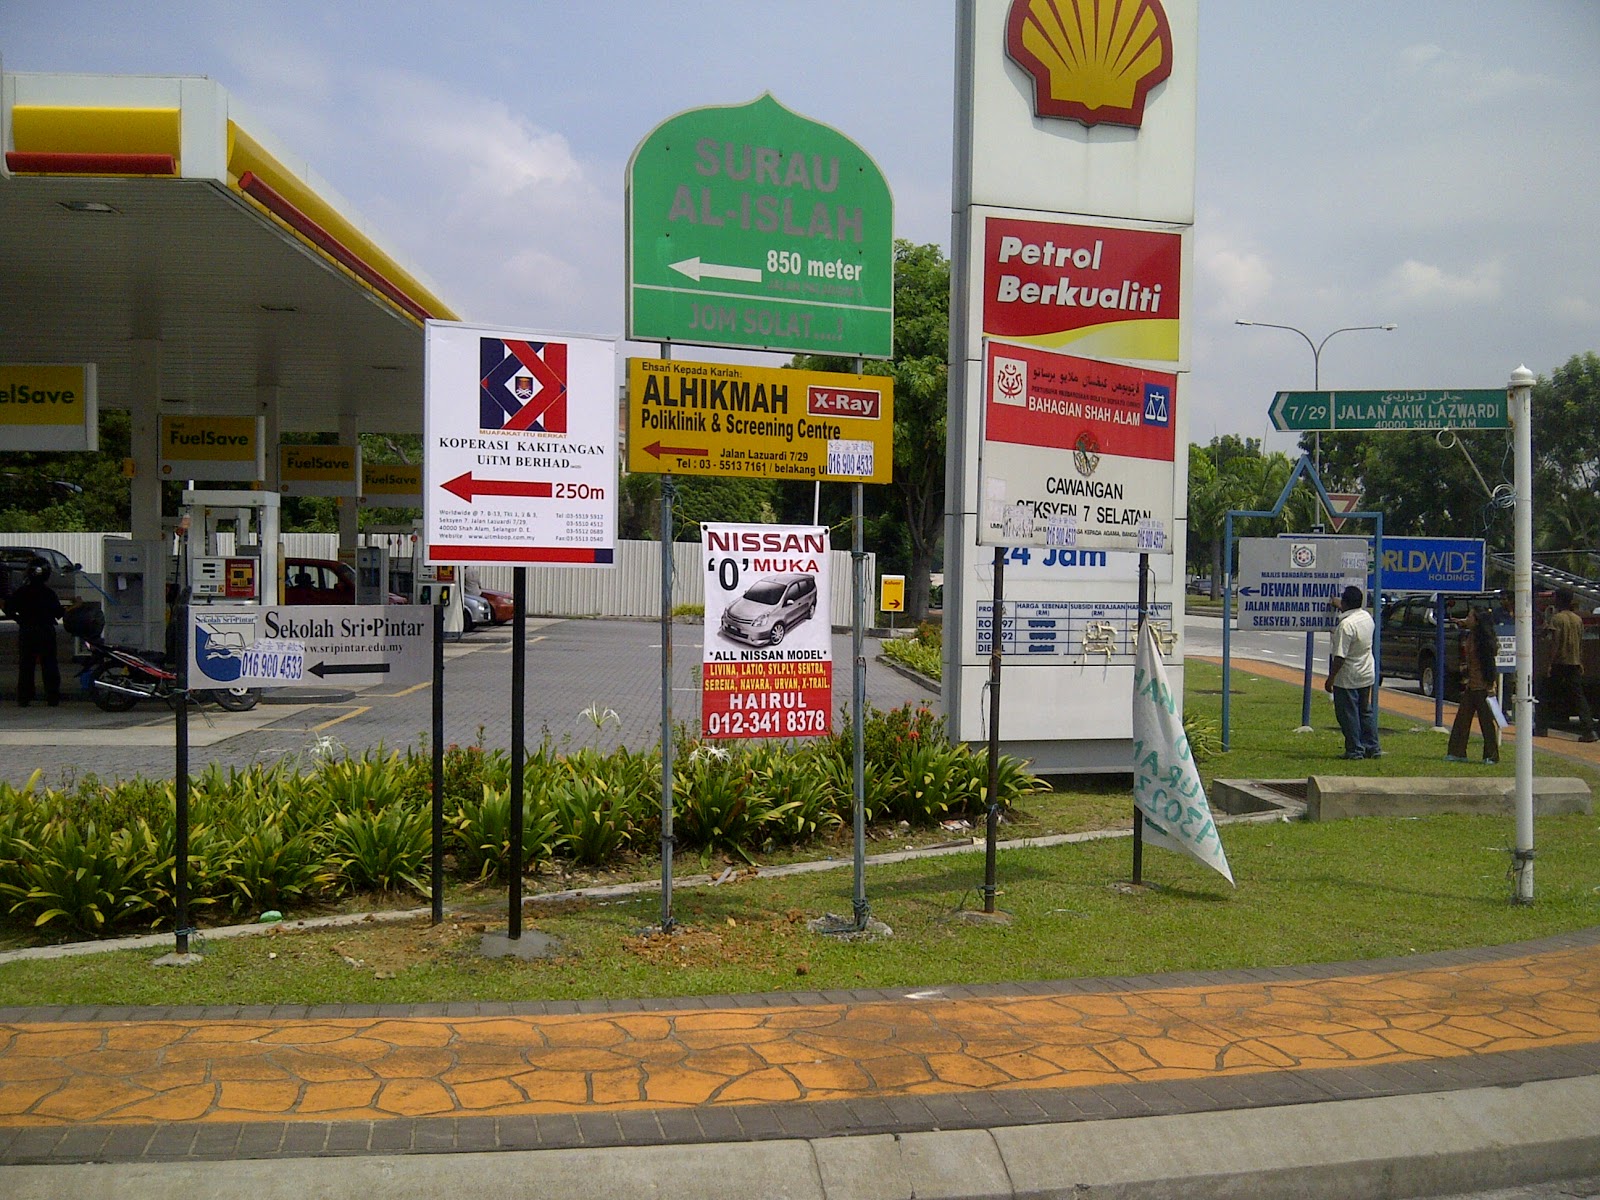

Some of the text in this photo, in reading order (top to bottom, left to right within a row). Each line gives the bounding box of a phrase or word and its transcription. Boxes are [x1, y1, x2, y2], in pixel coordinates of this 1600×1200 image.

[694, 137, 840, 193] SURAU
[668, 183, 864, 243] AL-ISLAH
[998, 236, 1103, 270] Petrol
[766, 250, 862, 281] 850 meter
[997, 275, 1162, 312] Berkualiti
[688, 303, 736, 333] JOM
[642, 361, 743, 378] Ehsan Kepada Kariah:
[642, 375, 788, 414] ALHIKMAH
[814, 392, 875, 415] X-Ray
[1028, 396, 1140, 426] BAHAGIAN SHAH ALAM
[1289, 403, 1499, 421] 7/29 JALAN AKIK LAZWARDI
[479, 429, 521, 437] MUAFAKAT
[641, 408, 841, 442] Poliklinik & Screening Centre
[1374, 420, 1477, 430] 40000 SHAH ALAM
[170, 431, 248, 446] FuelSave
[439, 437, 605, 455] KOPERASI KAKITANGAN
[287, 457, 349, 470] FuelSave
[477, 455, 511, 466] UiTM
[516, 456, 570, 469] BERHAD
[720, 448, 809, 462] Jalan Lazuardi 7/29
[676, 458, 691, 468] Tel
[699, 458, 711, 469] 03
[719, 460, 742, 471] 5513
[774, 463, 816, 476] belakang
[828, 453, 841, 474] 016
[856, 454, 873, 475] 4533
[365, 472, 417, 485] FuelSave
[555, 483, 605, 500] 250m
[1046, 476, 1124, 500] CAWANGAN
[1083, 505, 1091, 522] 7
[707, 531, 824, 553] NISSAN
[753, 558, 820, 573] MUKA
[1042, 548, 1107, 567] Jam
[1428, 574, 1475, 582] HOLDINGS
[1260, 582, 1300, 598] DEWAN
[1091, 610, 1105, 618] (RM)
[1244, 601, 1270, 612] JALAN
[1271, 601, 1310, 612] MARMAR
[264, 611, 334, 640] Sekolah
[1002, 620, 1014, 628] 97
[1253, 615, 1290, 627] SEKSYEN
[1299, 616, 1323, 627] SHAH
[1002, 632, 1014, 640] 92
[741, 650, 783, 661] NISSAN
[242, 652, 260, 677] 016
[280, 655, 303, 679] 4533
[709, 662, 739, 678] LIVINA,
[741, 662, 766, 678] LATIO,
[797, 662, 826, 676] SENTRA,
[704, 679, 738, 693] SERENA,
[740, 678, 772, 692] NAVARA,
[774, 678, 800, 692] URVAN,
[729, 692, 807, 710] HAIRUL
[709, 709, 825, 735] 012-341 8378
